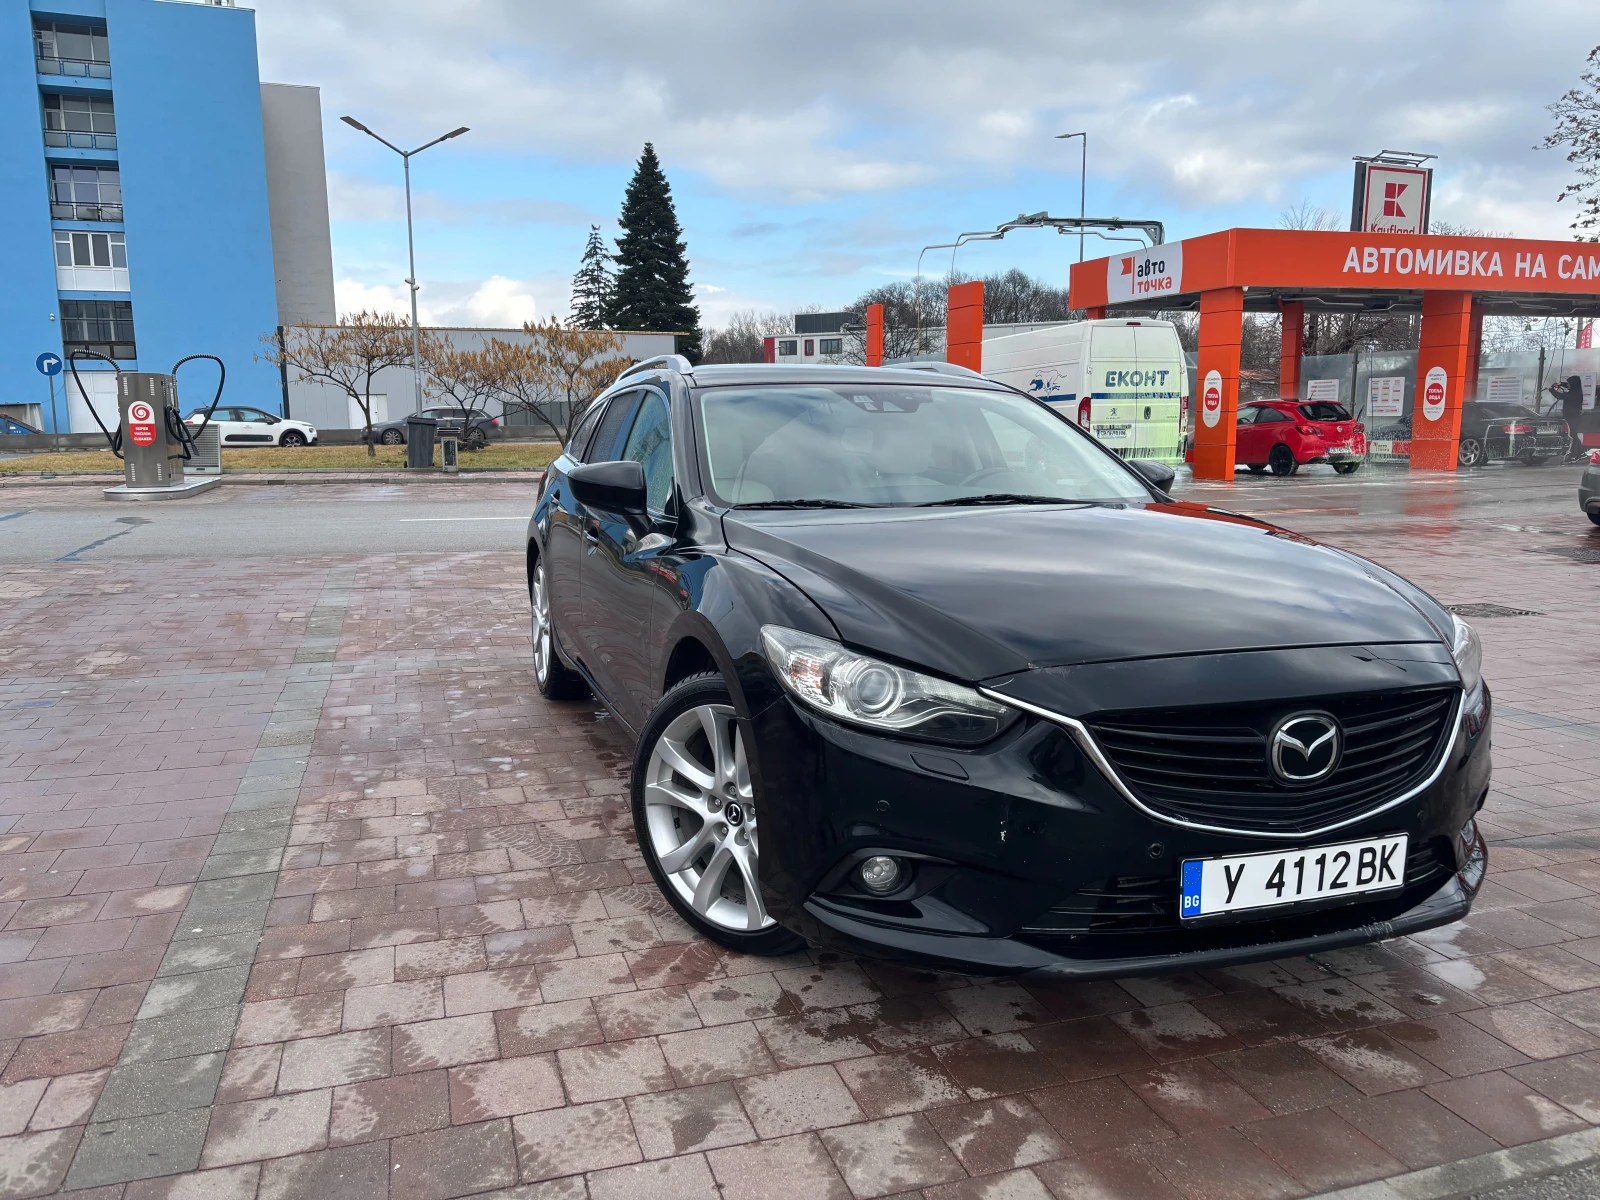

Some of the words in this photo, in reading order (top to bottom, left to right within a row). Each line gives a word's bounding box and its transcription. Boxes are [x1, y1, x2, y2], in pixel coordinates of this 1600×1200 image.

[1137, 259, 1165, 277] авто
[1342, 246, 1504, 277] АВТОМИВКА
[1514, 252, 1548, 278] НА
[1137, 276, 1173, 294] точка
[1105, 370, 1170, 388] ЕКОНТ
[1184, 895, 1200, 909] BG
